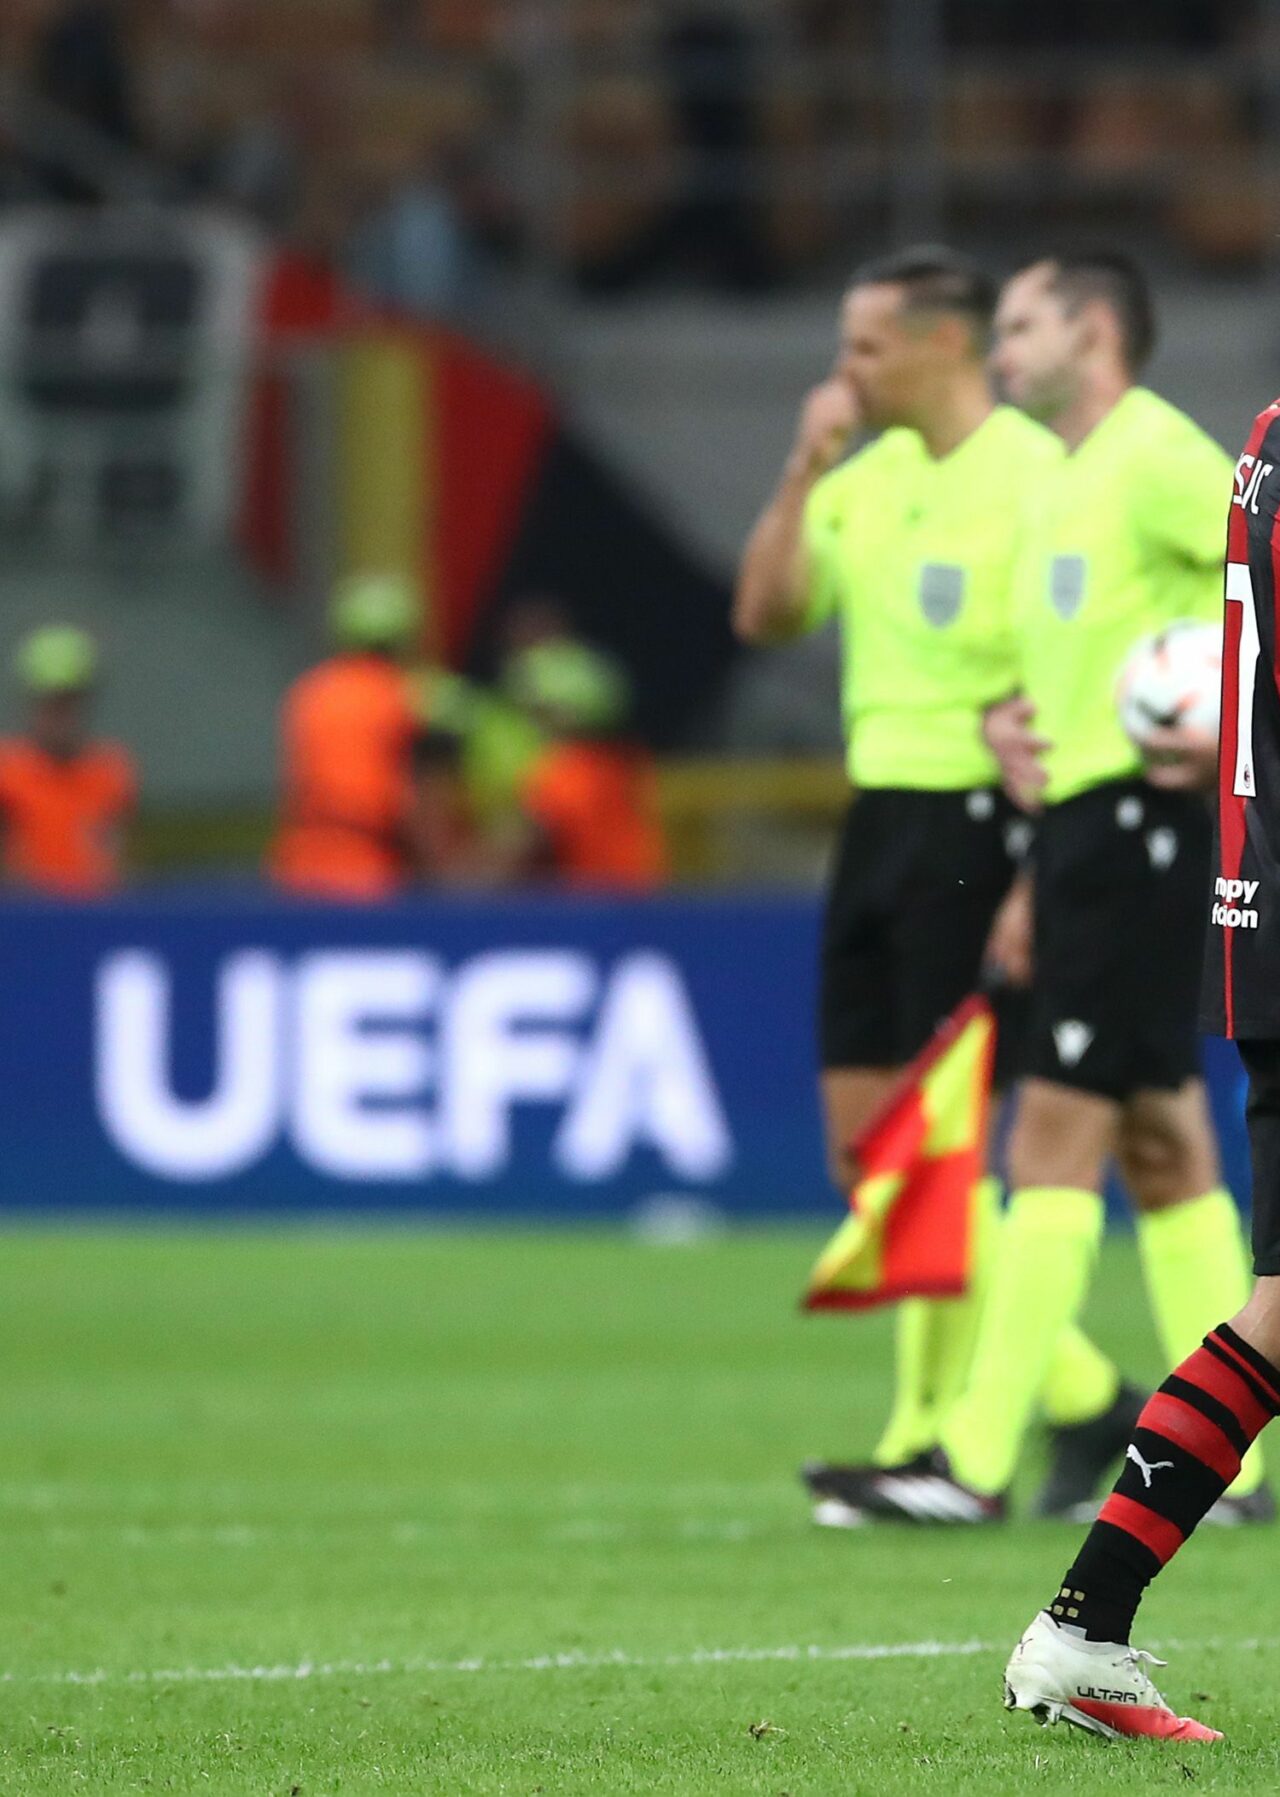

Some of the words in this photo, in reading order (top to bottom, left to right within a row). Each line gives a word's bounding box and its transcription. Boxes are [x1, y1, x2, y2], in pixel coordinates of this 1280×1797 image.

[1233, 452, 1274, 515] SIC
[95, 945, 734, 1182] UEFA
[1076, 1686, 1138, 1704] ULTRA
